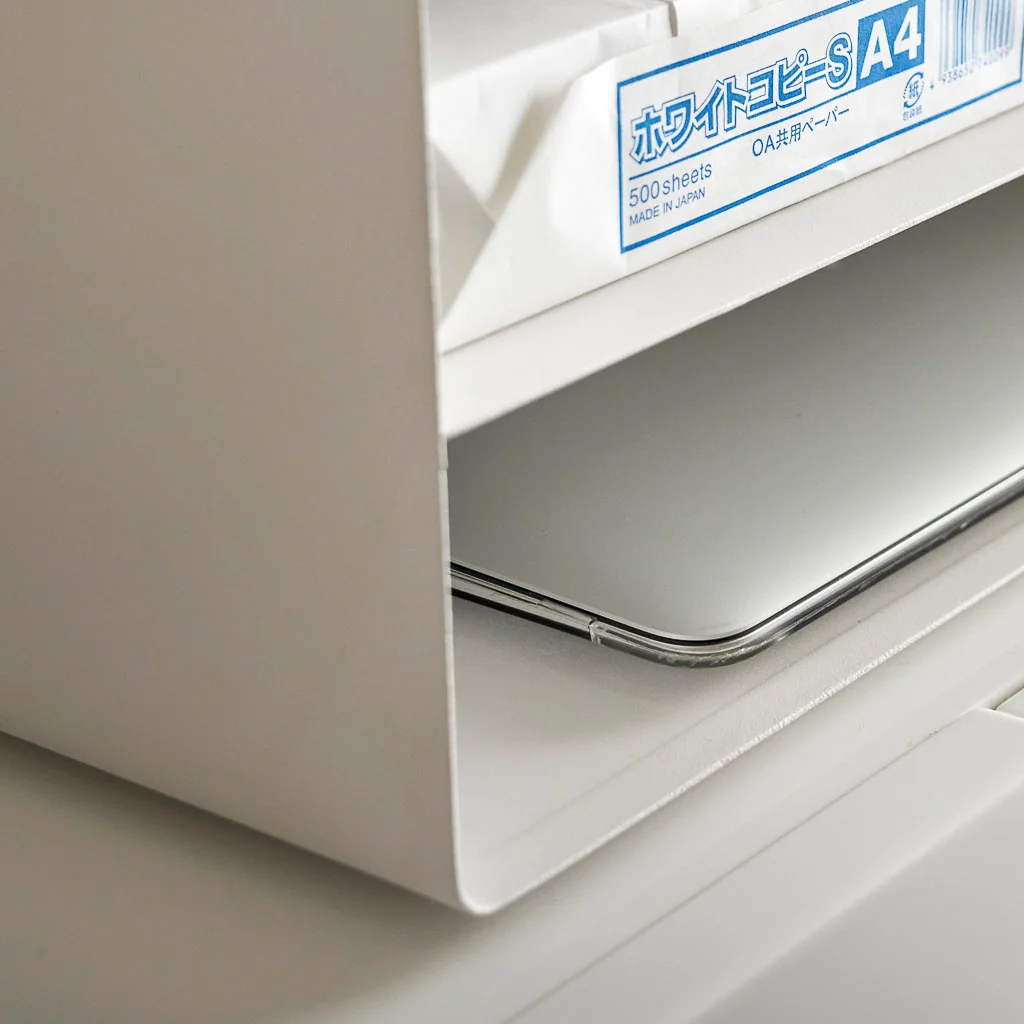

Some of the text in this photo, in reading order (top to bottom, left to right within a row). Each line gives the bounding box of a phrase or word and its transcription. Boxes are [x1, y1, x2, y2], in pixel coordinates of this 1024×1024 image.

[629, 5, 923, 164] ホワイトコピーS A4
[752, 106, 850, 157] OA共用ペーパー
[629, 186, 706, 226] MADE IN JAPAN
